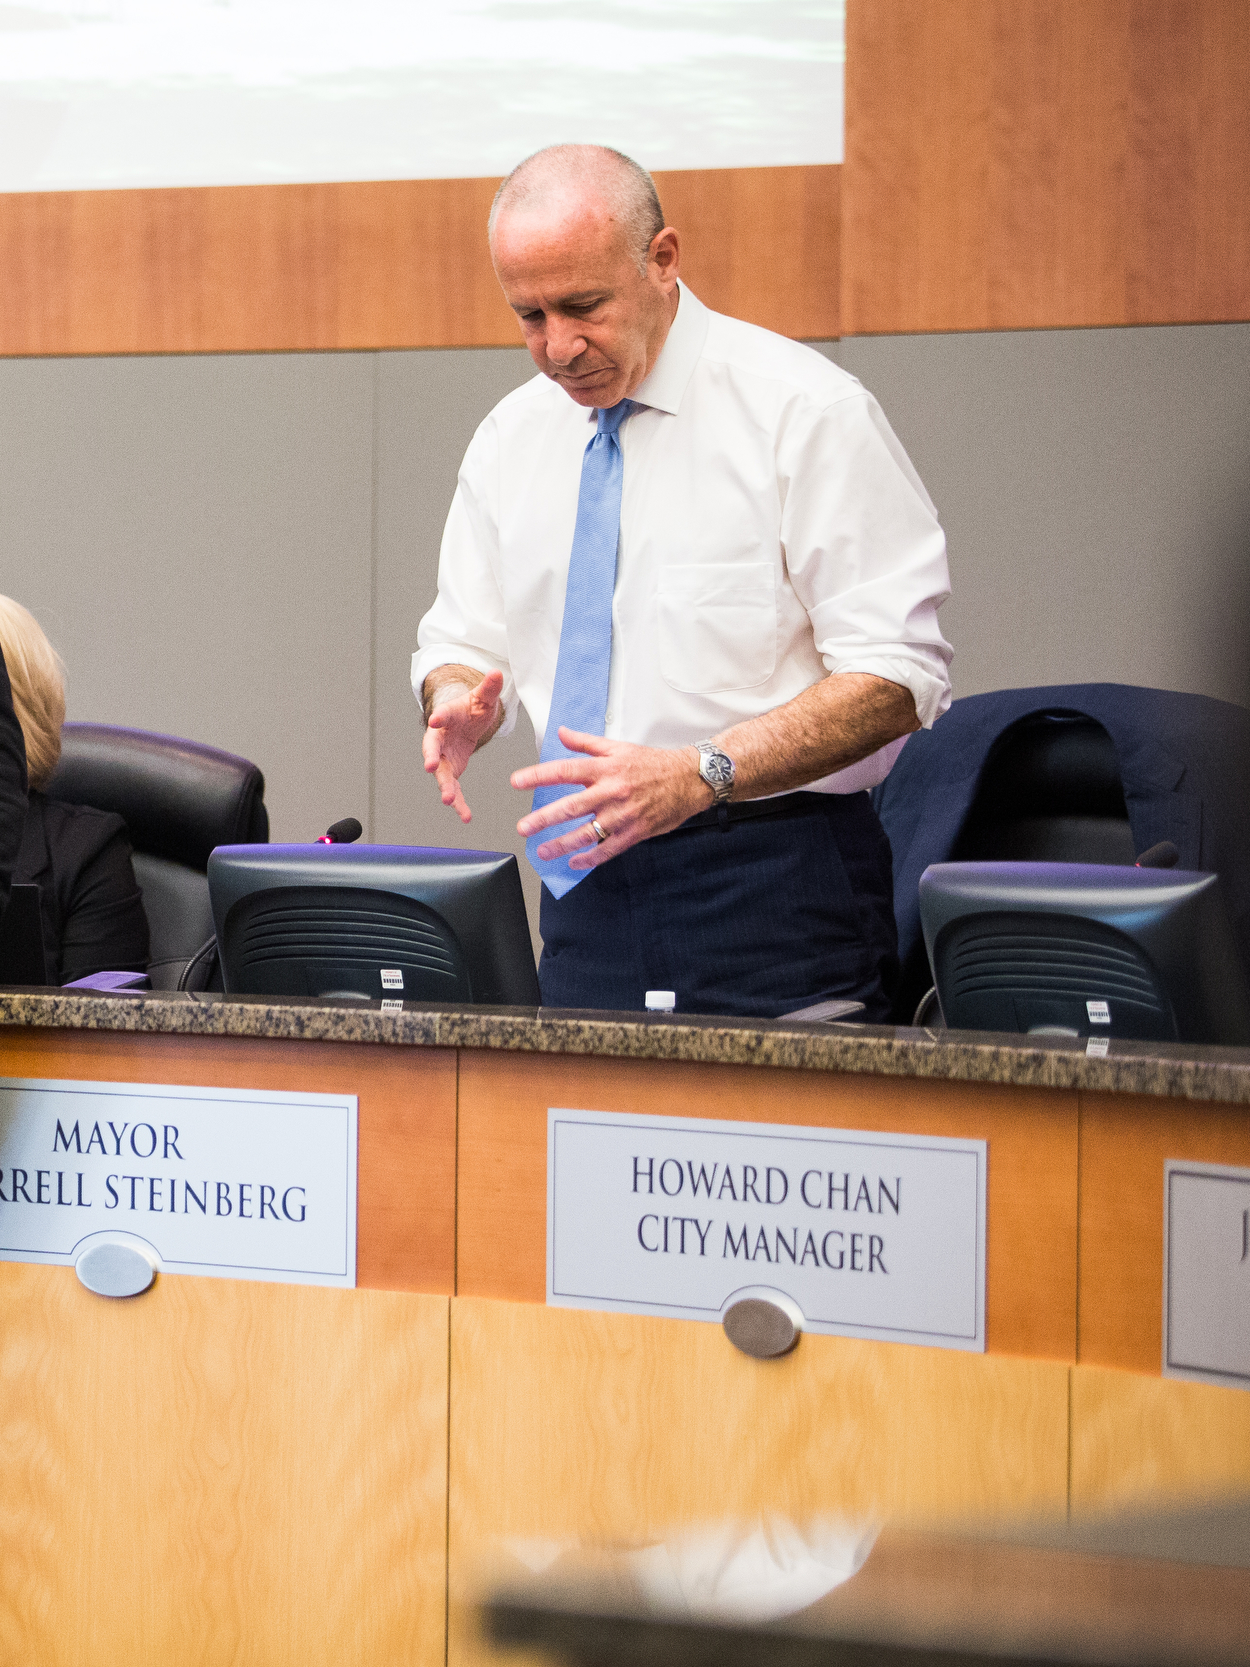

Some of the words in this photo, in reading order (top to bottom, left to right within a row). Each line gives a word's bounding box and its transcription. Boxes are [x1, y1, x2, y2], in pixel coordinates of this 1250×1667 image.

[52, 1117, 185, 1160] MAYOR
[104, 1174, 308, 1222] STEINBERG
[631, 1156, 788, 1205] HOWARD
[800, 1169, 902, 1216] CHAN
[637, 1213, 713, 1256] CITY
[722, 1221, 889, 1275] MANAGER
